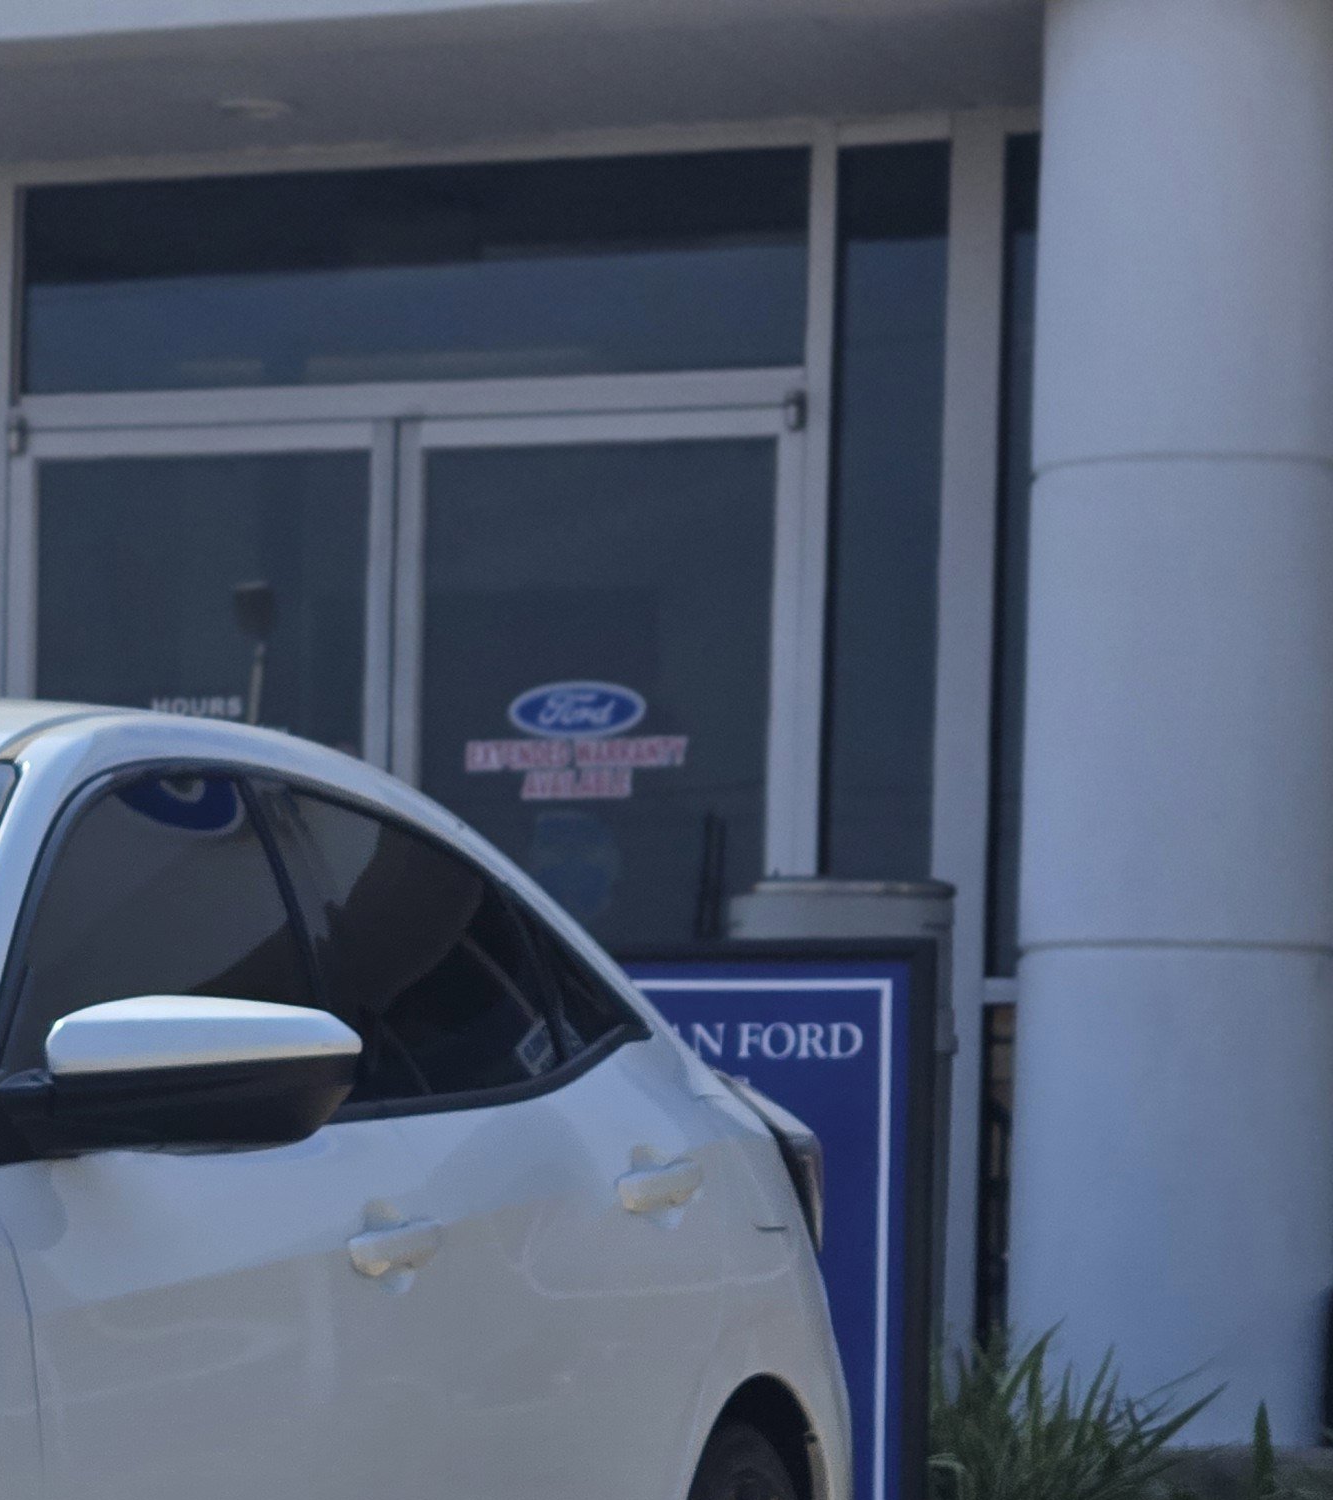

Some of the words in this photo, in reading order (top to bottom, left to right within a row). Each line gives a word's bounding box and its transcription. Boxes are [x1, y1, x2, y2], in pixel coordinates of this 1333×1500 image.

[151, 697, 242, 717] HOURS
[538, 692, 615, 726] Ford
[738, 1021, 863, 1059] FORD
